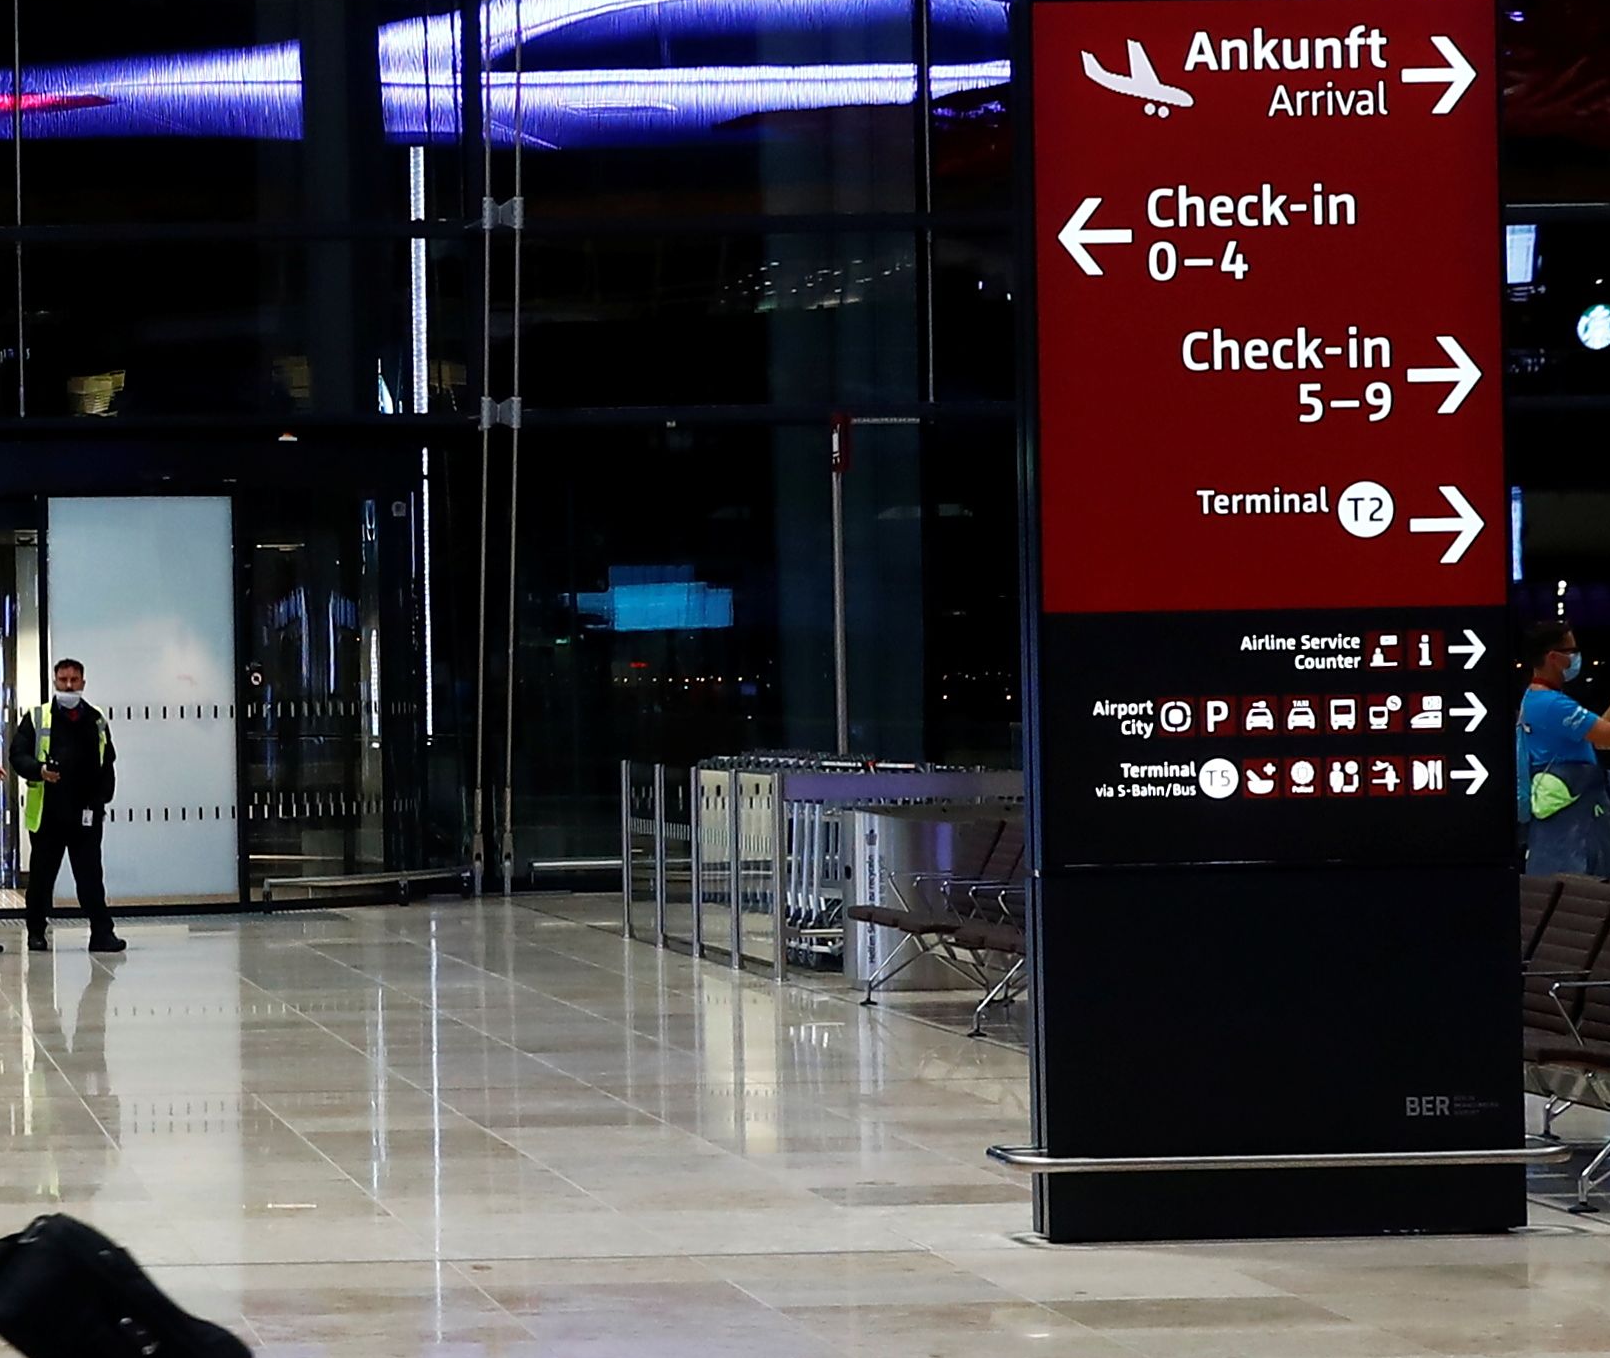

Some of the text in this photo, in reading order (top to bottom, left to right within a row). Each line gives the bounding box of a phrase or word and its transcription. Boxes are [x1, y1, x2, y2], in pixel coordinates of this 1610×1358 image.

[1184, 24, 1388, 71] Ankunft
[1268, 80, 1389, 117] Arrival
[1147, 183, 1356, 228] Check-in
[1182, 326, 1391, 371] Check-in
[1196, 486, 1384, 522] Terminal T2
[1240, 633, 1361, 651] Airline Service
[1294, 654, 1362, 670] Counter
[1092, 699, 1154, 718] Airport
[1120, 719, 1154, 739] City
[1120, 760, 1197, 779] Terminal
[1095, 781, 1197, 800] via S-Bahn/Bus
[1405, 1096, 1451, 1117] BER
